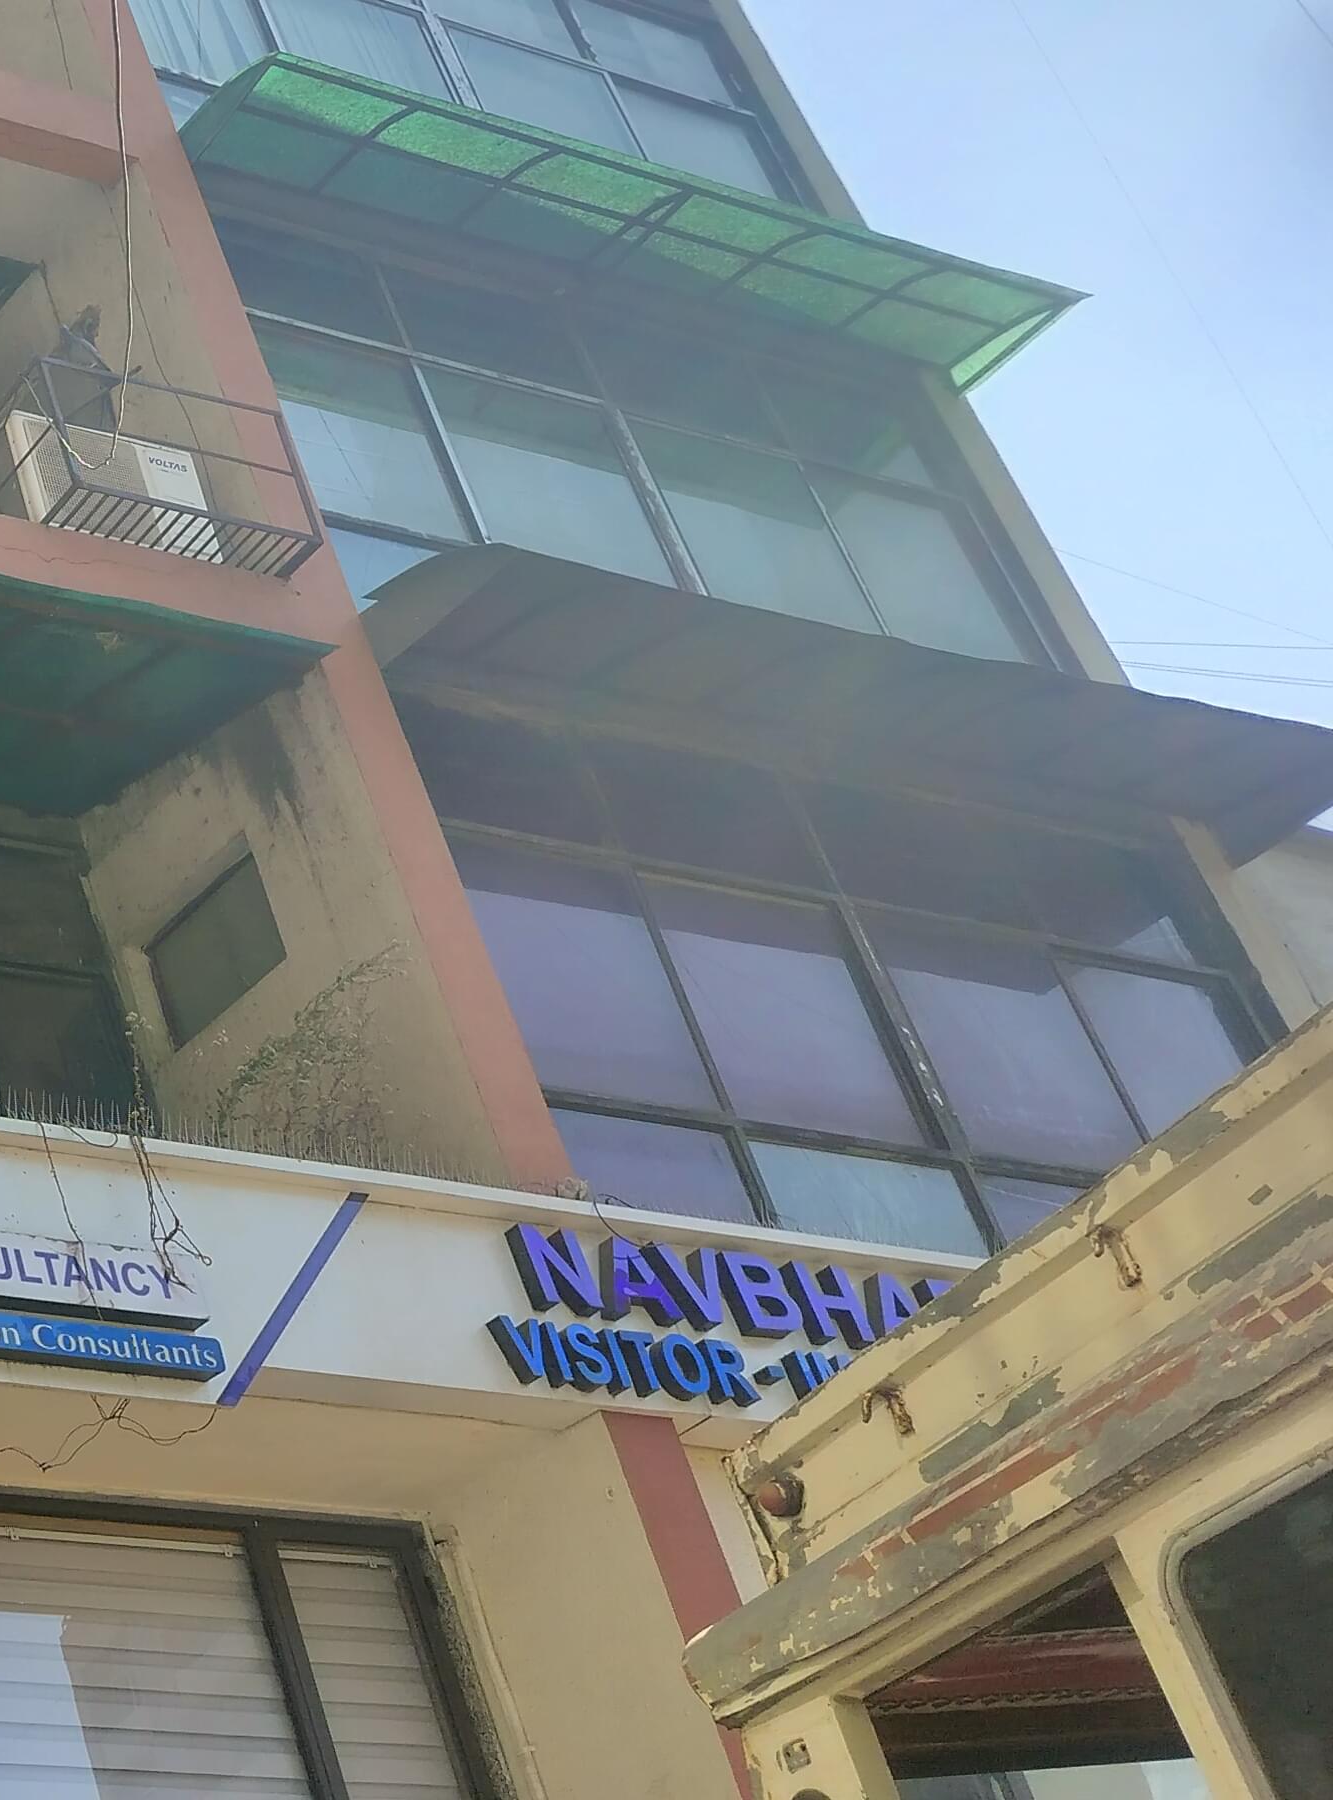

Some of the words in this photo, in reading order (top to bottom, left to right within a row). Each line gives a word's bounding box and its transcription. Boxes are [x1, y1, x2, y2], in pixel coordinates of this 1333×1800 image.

[148, 456, 188, 473] VOLTAS
[505, 1223, 955, 1350] NAVBHA
[31, 1322, 220, 1371] Consultants
